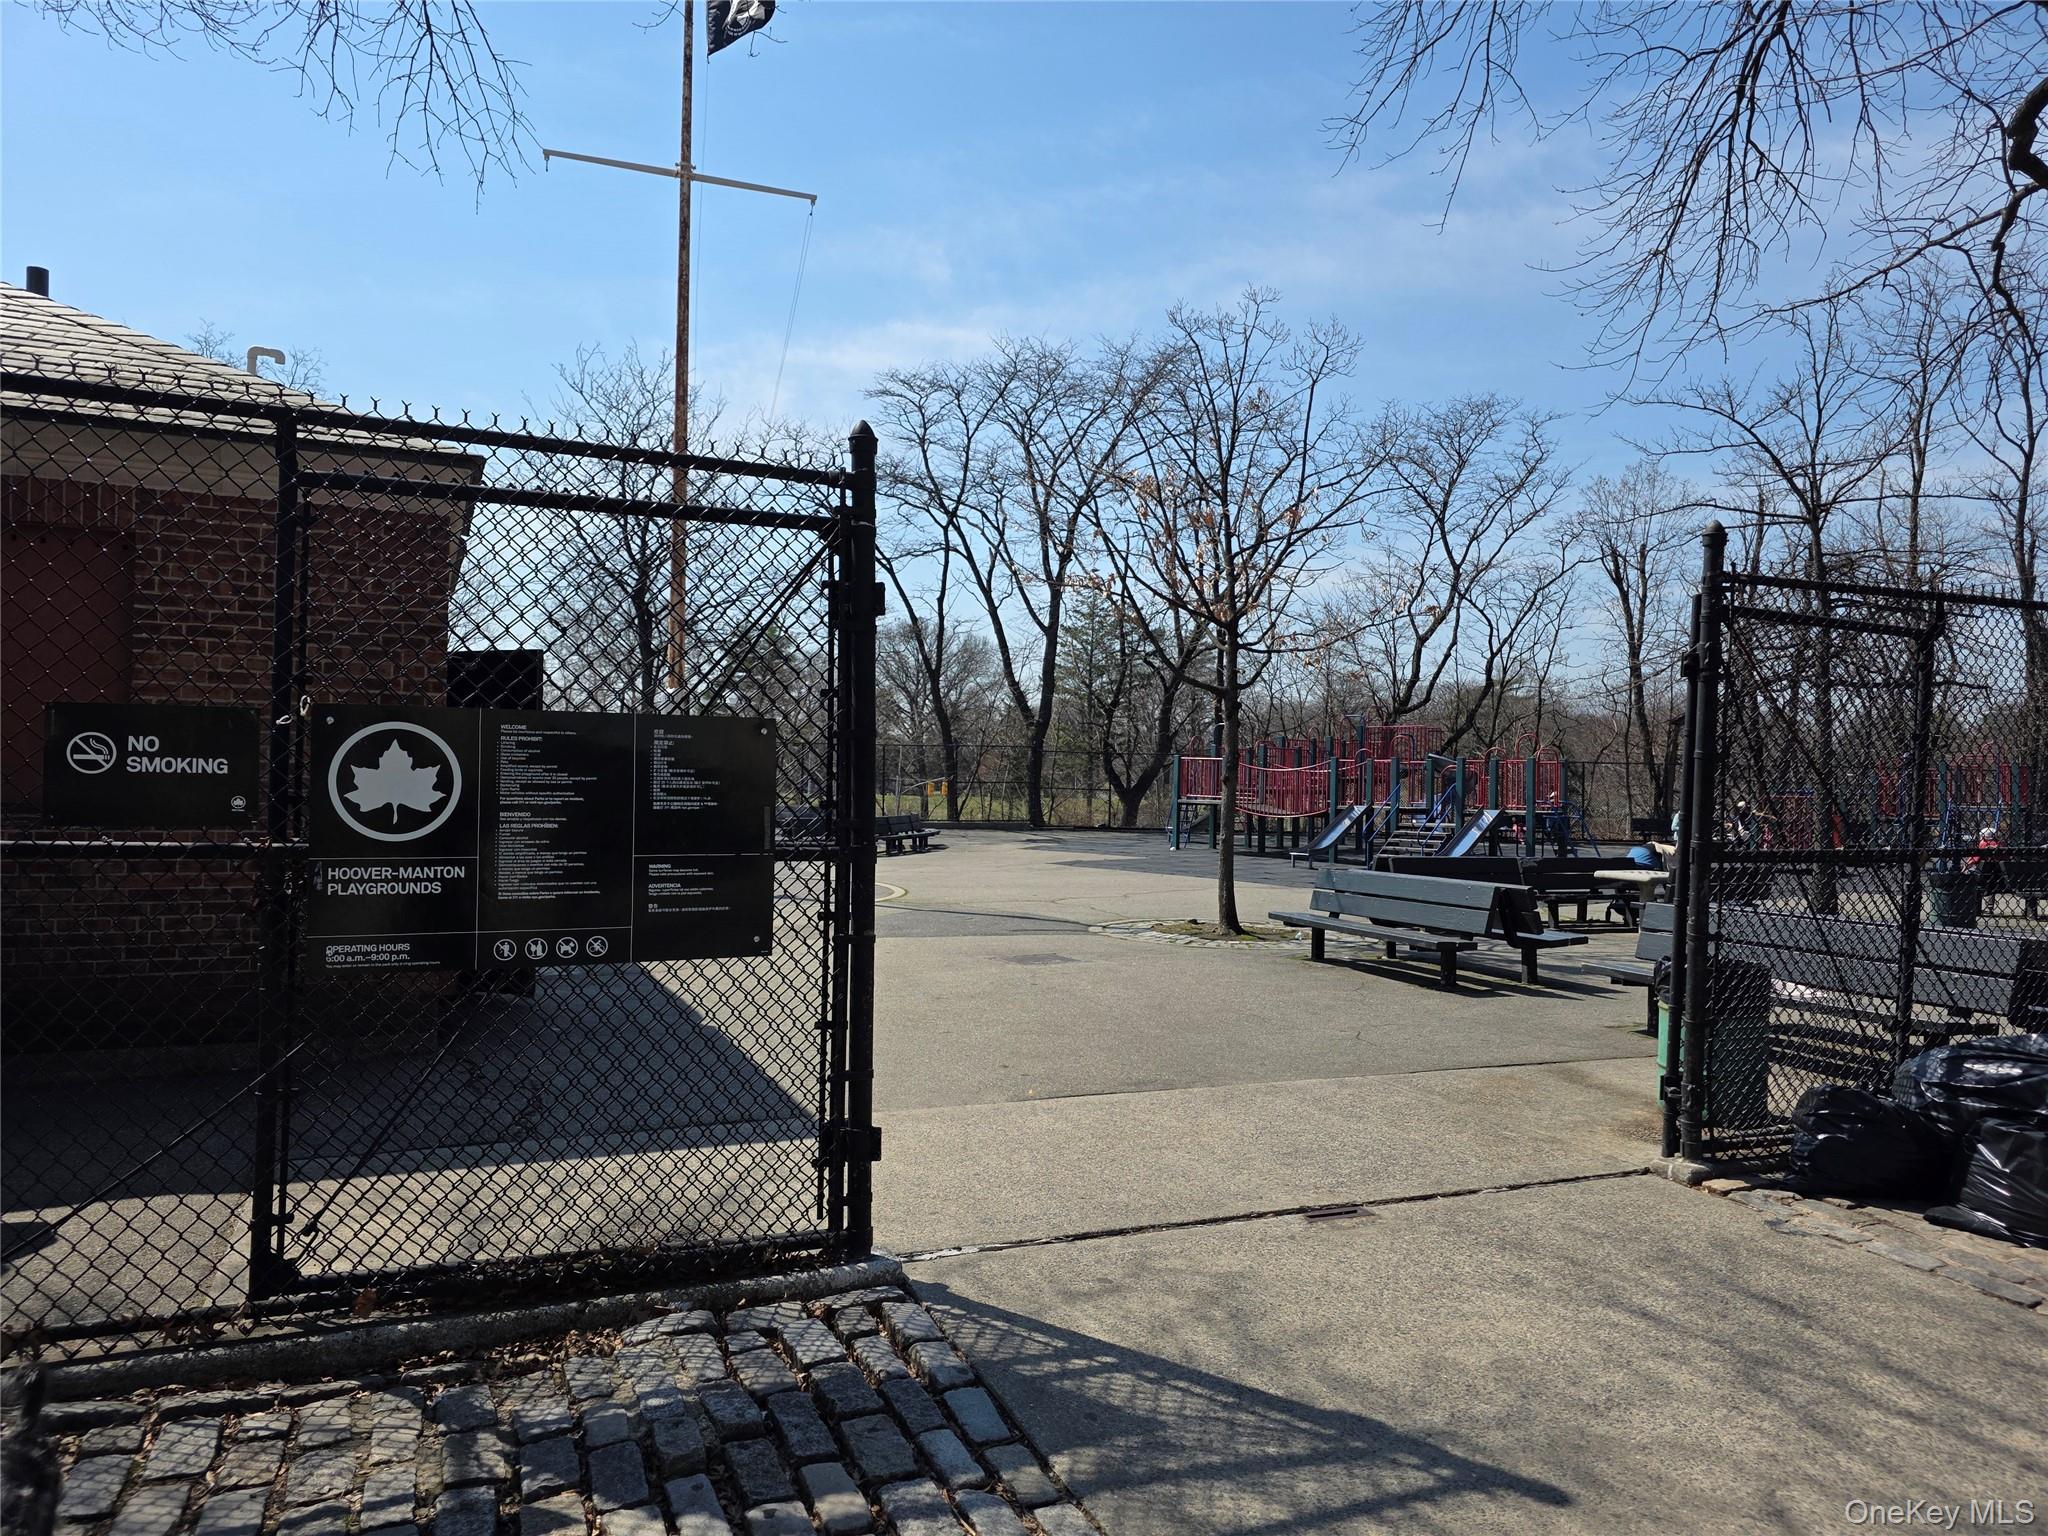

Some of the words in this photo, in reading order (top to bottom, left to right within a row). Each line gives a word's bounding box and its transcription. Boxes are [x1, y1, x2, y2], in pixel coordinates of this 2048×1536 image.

[127, 735, 160, 752] NO
[126, 756, 229, 774] SMOKING
[327, 866, 465, 880] HOOVER-MANTON
[327, 881, 442, 896] PLAYGROUNDS
[326, 944, 377, 953] OPERATING
[378, 943, 410, 951] HOURS
[391, 953, 410, 963] p.m.
